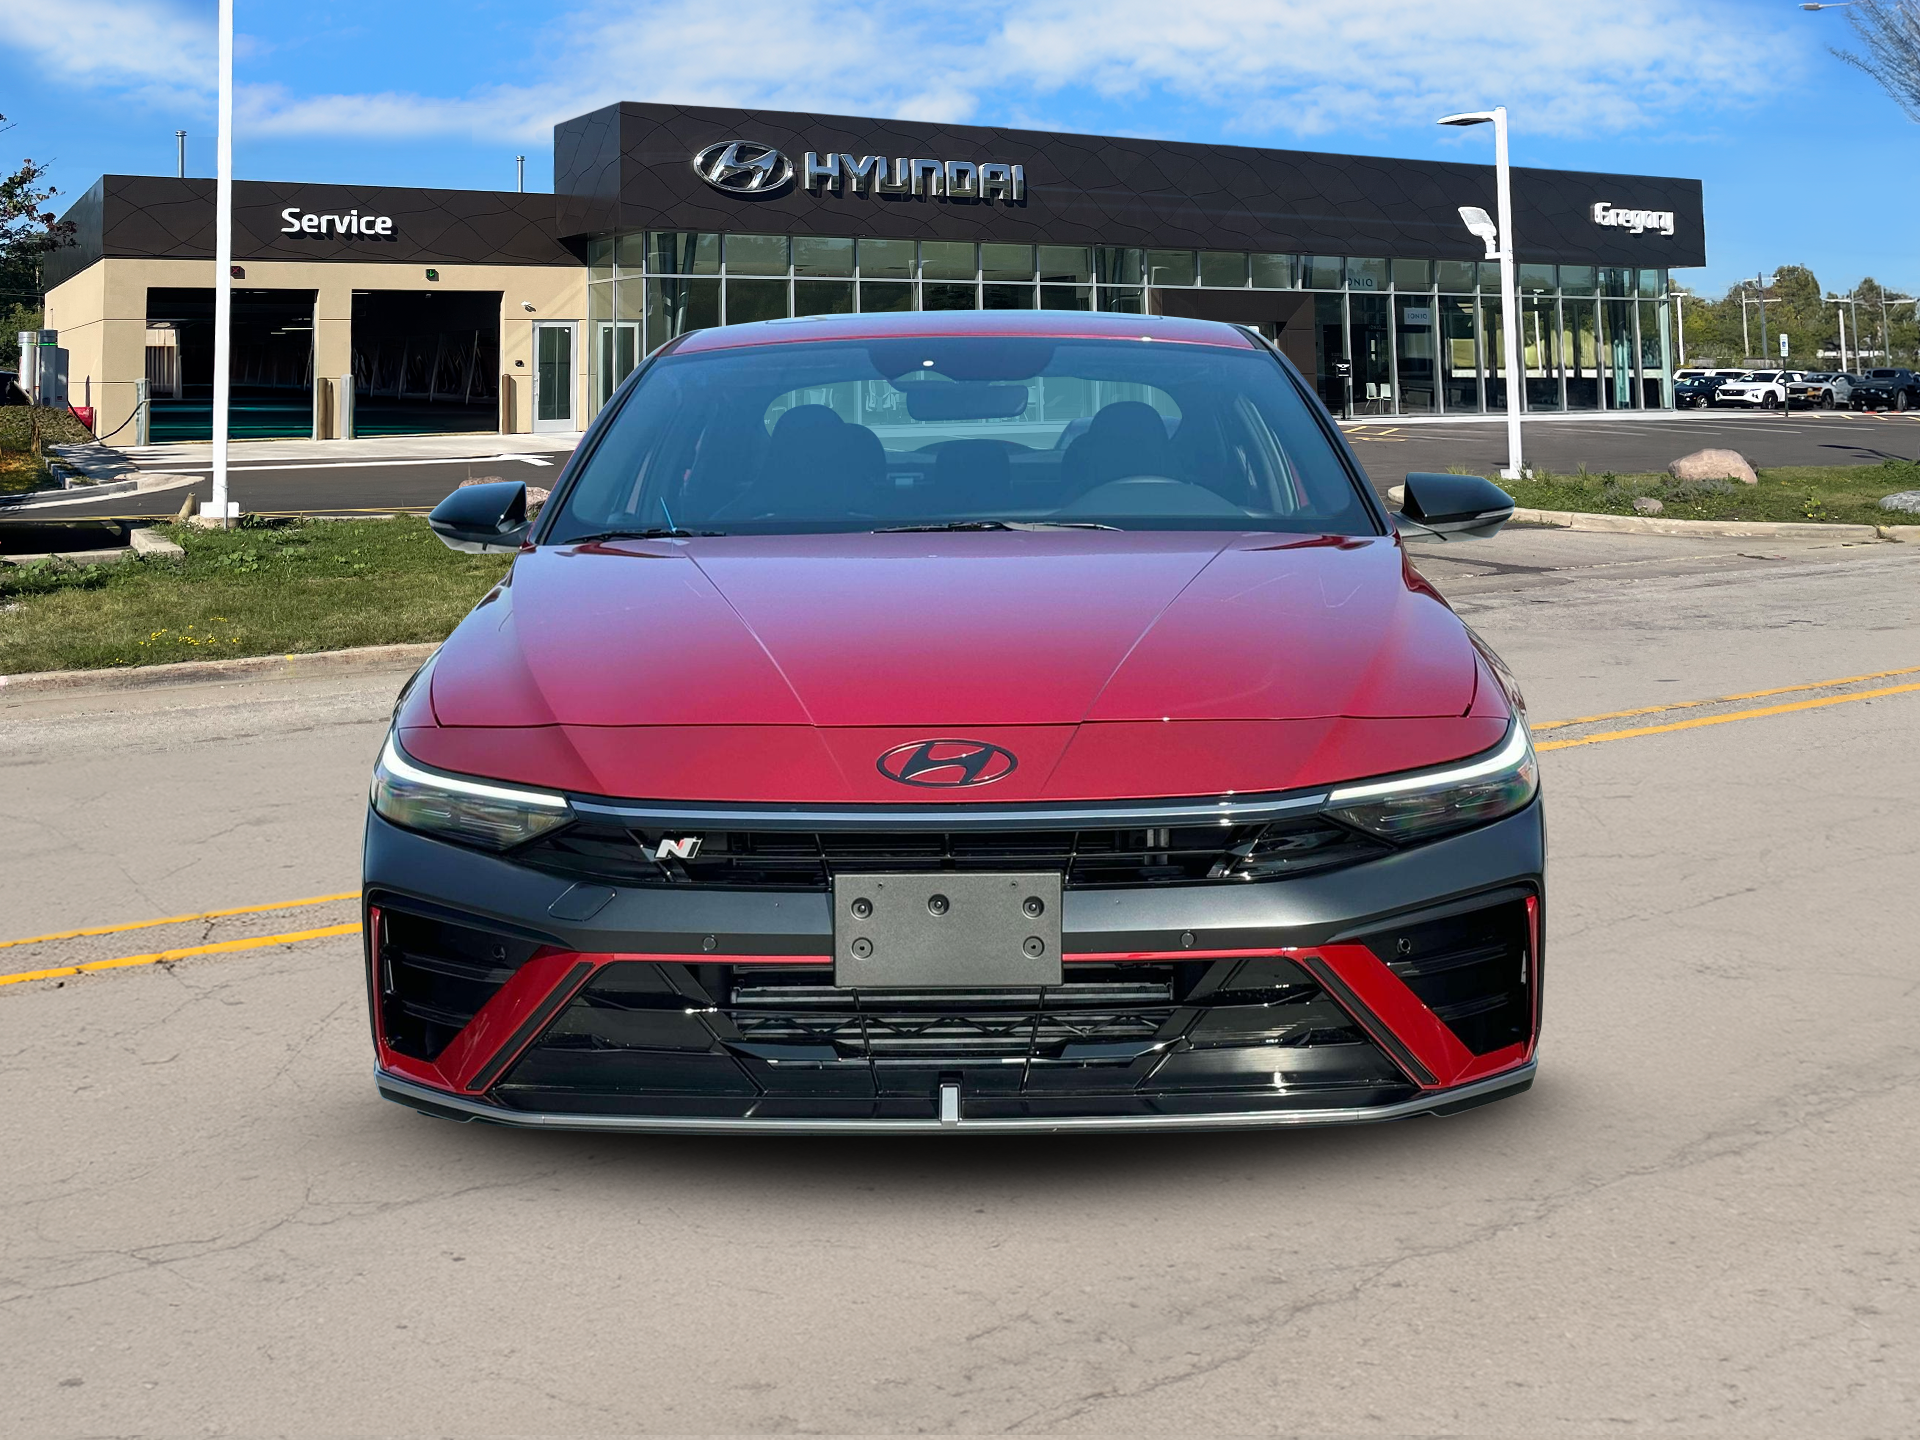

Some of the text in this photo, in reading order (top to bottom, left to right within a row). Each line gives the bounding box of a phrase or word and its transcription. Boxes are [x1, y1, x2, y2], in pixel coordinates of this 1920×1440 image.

[804, 151, 1025, 200] HYUNDAI
[280, 207, 393, 235] Service
[1593, 202, 1675, 236] Gregory
